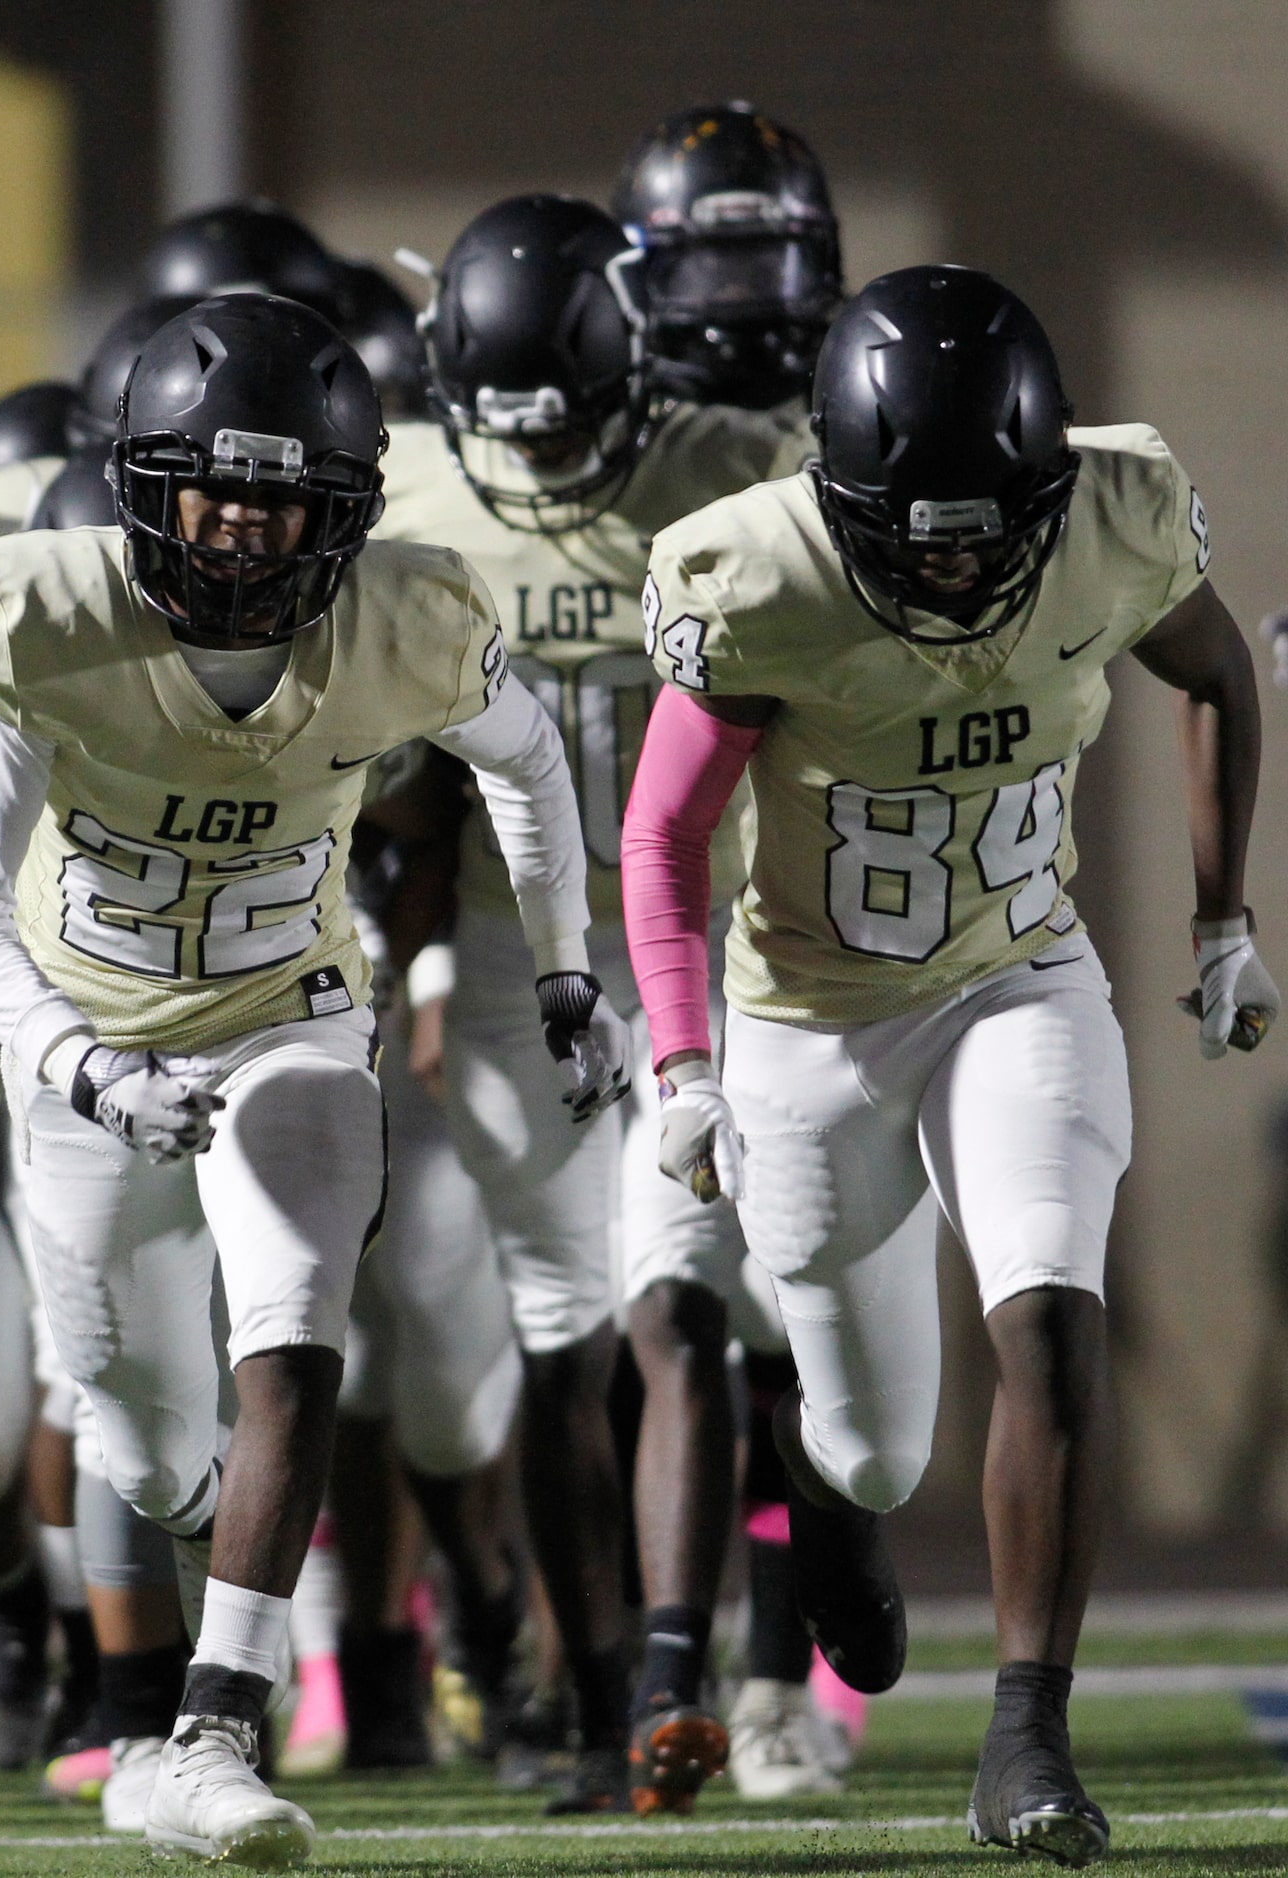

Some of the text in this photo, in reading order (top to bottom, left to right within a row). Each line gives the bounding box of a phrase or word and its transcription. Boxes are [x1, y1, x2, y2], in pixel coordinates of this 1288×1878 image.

[515, 579, 614, 642] LGP
[640, 569, 710, 693] 84
[918, 704, 1030, 775] LGP
[153, 794, 278, 844] LGP
[57, 808, 337, 979] 22
[824, 759, 1066, 965] 84
[316, 972, 330, 987] S
